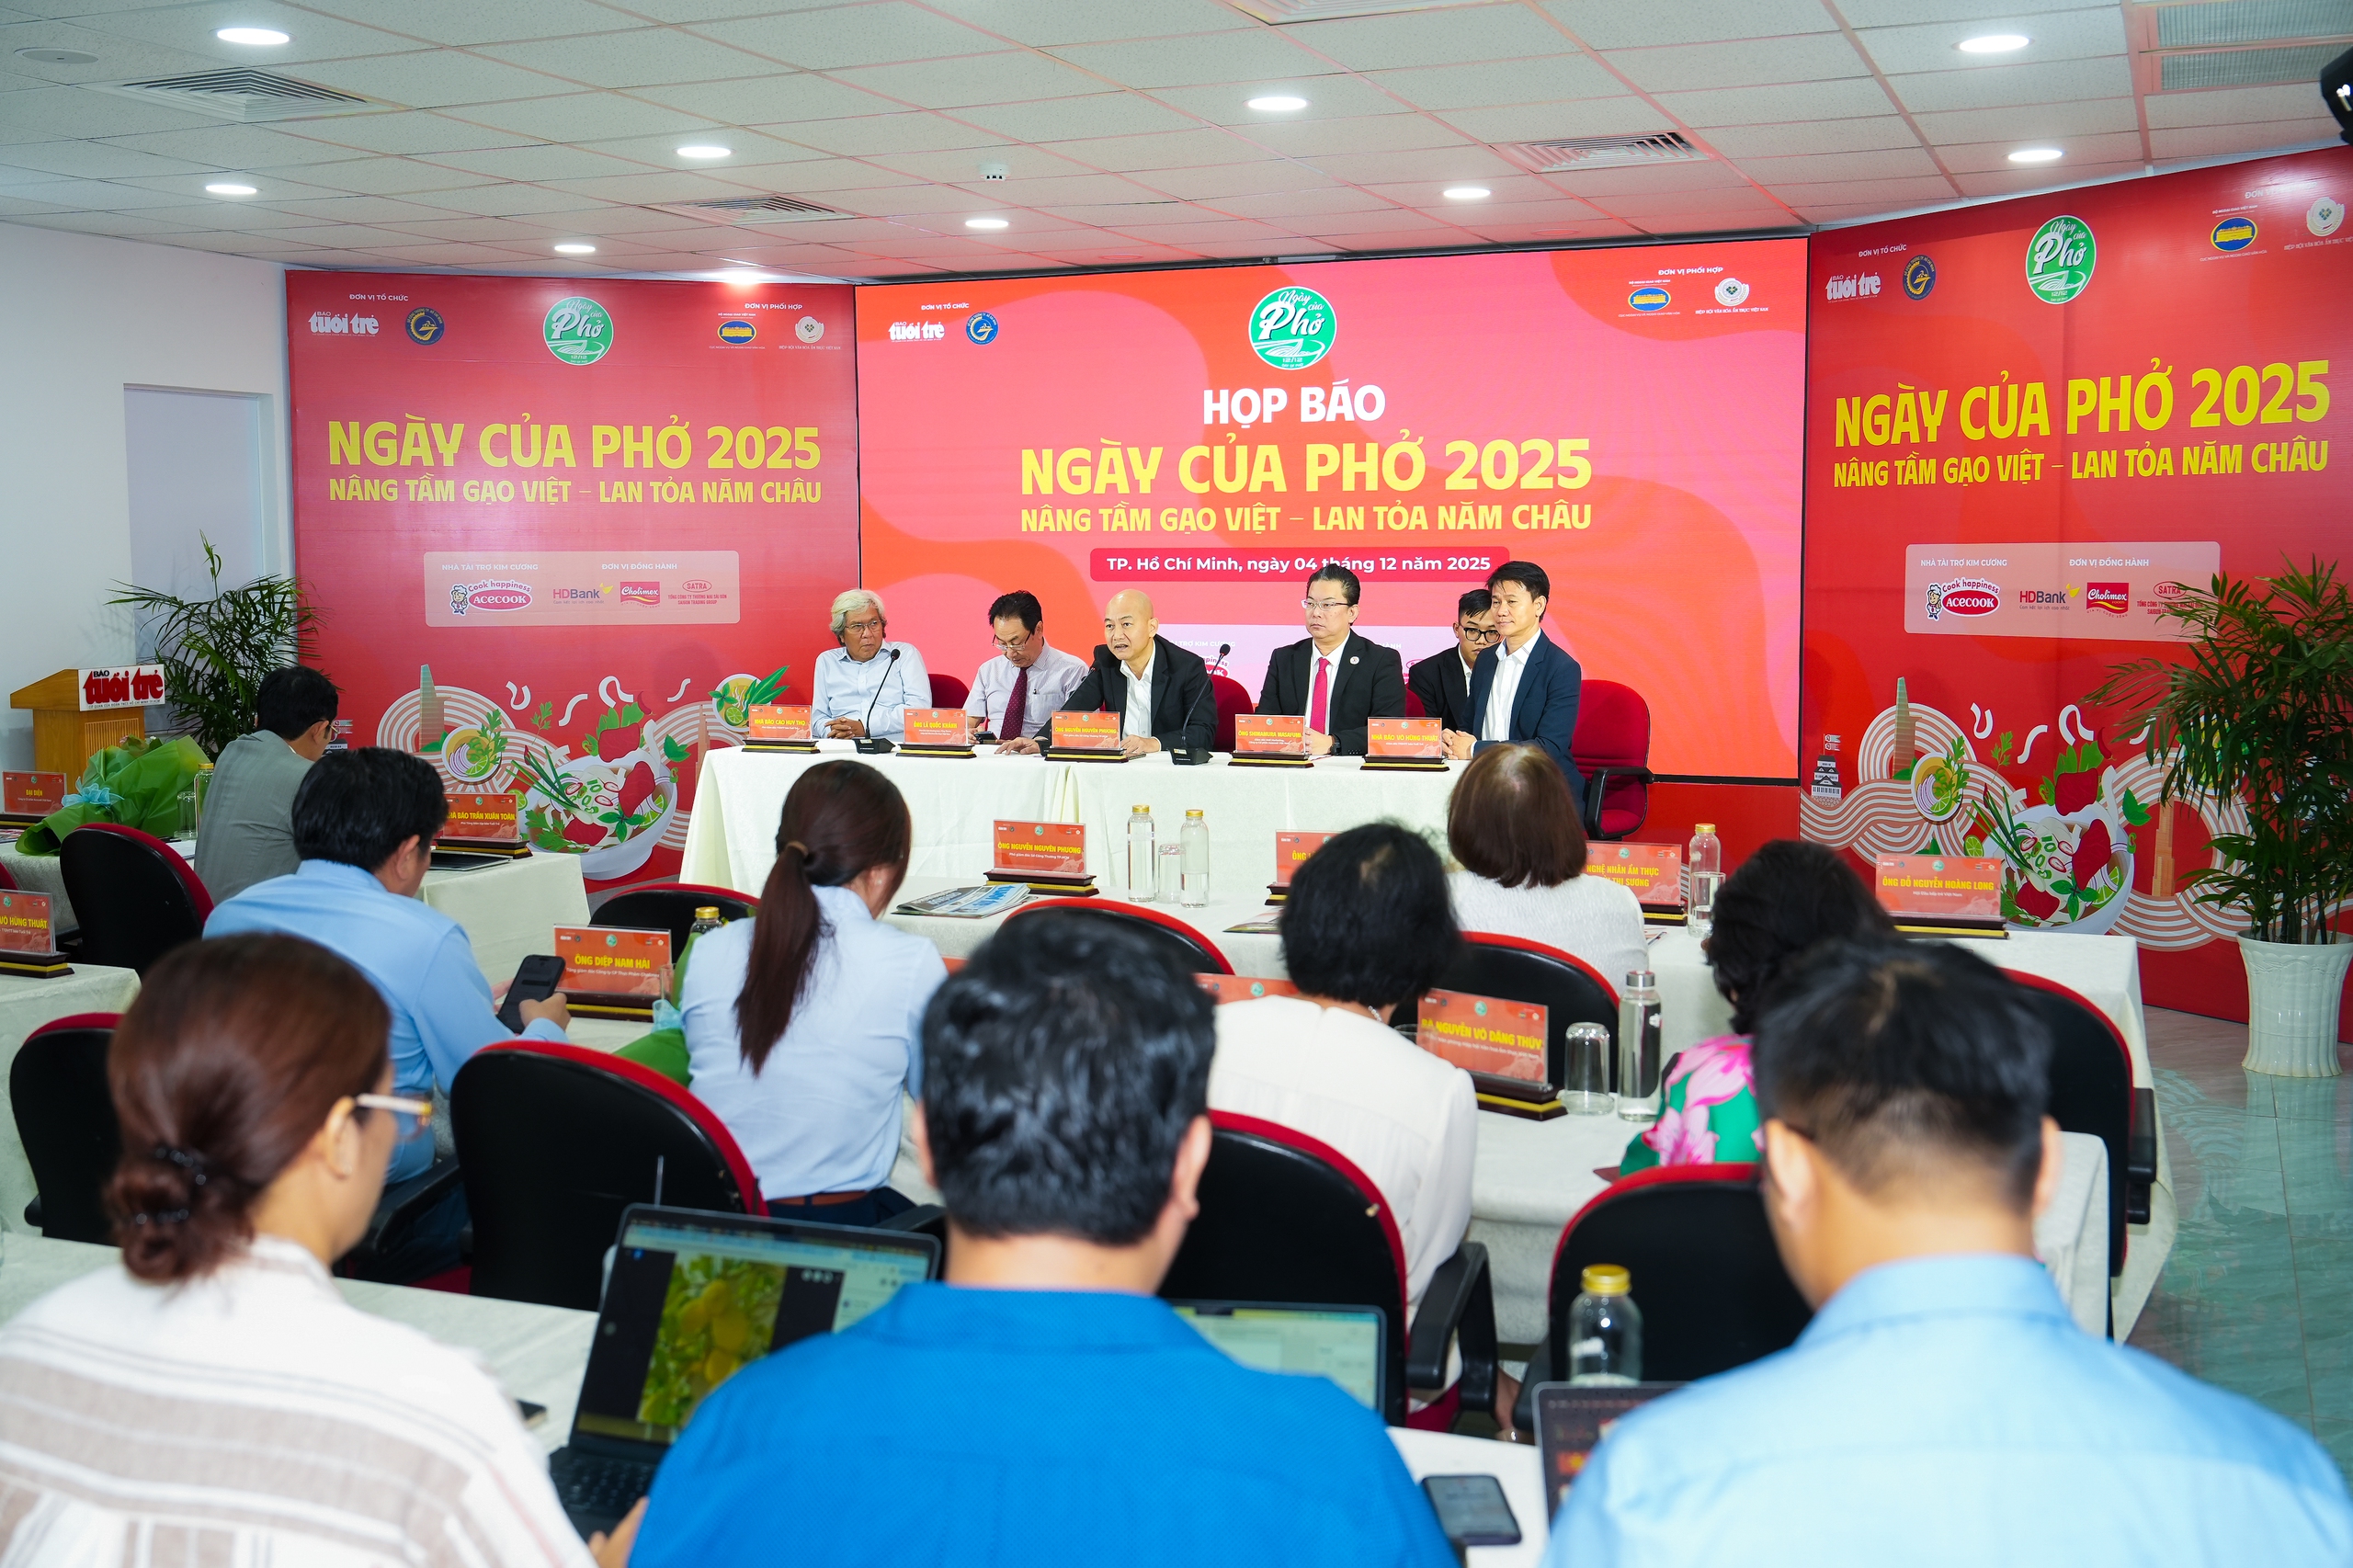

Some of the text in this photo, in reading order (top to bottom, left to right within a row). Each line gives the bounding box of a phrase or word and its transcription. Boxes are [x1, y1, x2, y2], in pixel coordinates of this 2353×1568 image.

[2245, 190, 2264, 199] ĐƠN
[2050, 219, 2076, 235] Ngày
[1881, 245, 1888, 254] TỔ
[1890, 244, 1906, 252] CHỨC
[2033, 232, 2087, 275] Phở
[566, 300, 593, 312] Ngày
[1278, 290, 1324, 311] Ngày của
[551, 308, 605, 339] Phở
[1258, 301, 1325, 340] Phở
[1203, 378, 1386, 428] HỌP BÁO
[1836, 358, 2330, 448] NGÀY CỦA PHỞ 2025
[329, 413, 821, 469] NGÀY CỦA PHỞ 2025
[1022, 428, 1592, 494] NGÀY CỦA PHỞ 2025
[1834, 435, 2328, 487] NÂNG TẦM GẠO VIỆT LAN TỎA NĂM CHÂU
[329, 472, 821, 505] NÂNG TẦM GẠO VIỆT LAN TỎA NĂM CHÂU
[1021, 499, 1591, 534] NÂNG TẦM GẠO VIỆT LAN TỎA NĂM CHÂU
[476, 563, 492, 572] TRỢ
[1107, 556, 1490, 574] TP. Hồ Chí Minh, ngày 04 tháng 12 năm 2025
[1921, 558, 1936, 566] NHÀ
[1938, 558, 1949, 566] TÀI
[1950, 559, 1965, 568] TRỢ
[1982, 558, 2007, 566] CƯƠNG
[2070, 557, 2149, 568] ĐƠN VỊ ĐỒNG HÀNH
[469, 581, 530, 593] Cook happiness
[553, 588, 600, 599] HDBank
[621, 586, 659, 596] Cholimex
[1942, 580, 1999, 594] Cook happiness
[2159, 586, 2180, 595] SATRA
[2019, 591, 2066, 604] HDBank
[2088, 589, 2127, 600] Cholimex
[93, 669, 109, 677] BÁO
[470, 811, 483, 819] TRẦN
[484, 812, 499, 820] XUÂN
[998, 841, 1009, 849] ÔNG
[1011, 842, 1032, 850] NGUYỄN
[1034, 844, 1055, 852] NGUYÊN
[1292, 850, 1306, 860] ÔNG
[1587, 864, 1659, 877] NGHỆ NHÂN ẨM THỰC
[1626, 878, 1649, 887] SƯƠNG
[1882, 876, 1994, 891] ÔNG ĐỖ NGUYỄN HOÀNG LONG
[10, 916, 48, 929] HÙNG THUẬT
[574, 954, 651, 969] ÔNG DIỆP NAM HẢI
[1436, 1021, 1472, 1038] NGUYỄN
[1490, 1029, 1515, 1046] ĐĂNG
[1517, 1035, 1542, 1050] THÚY
